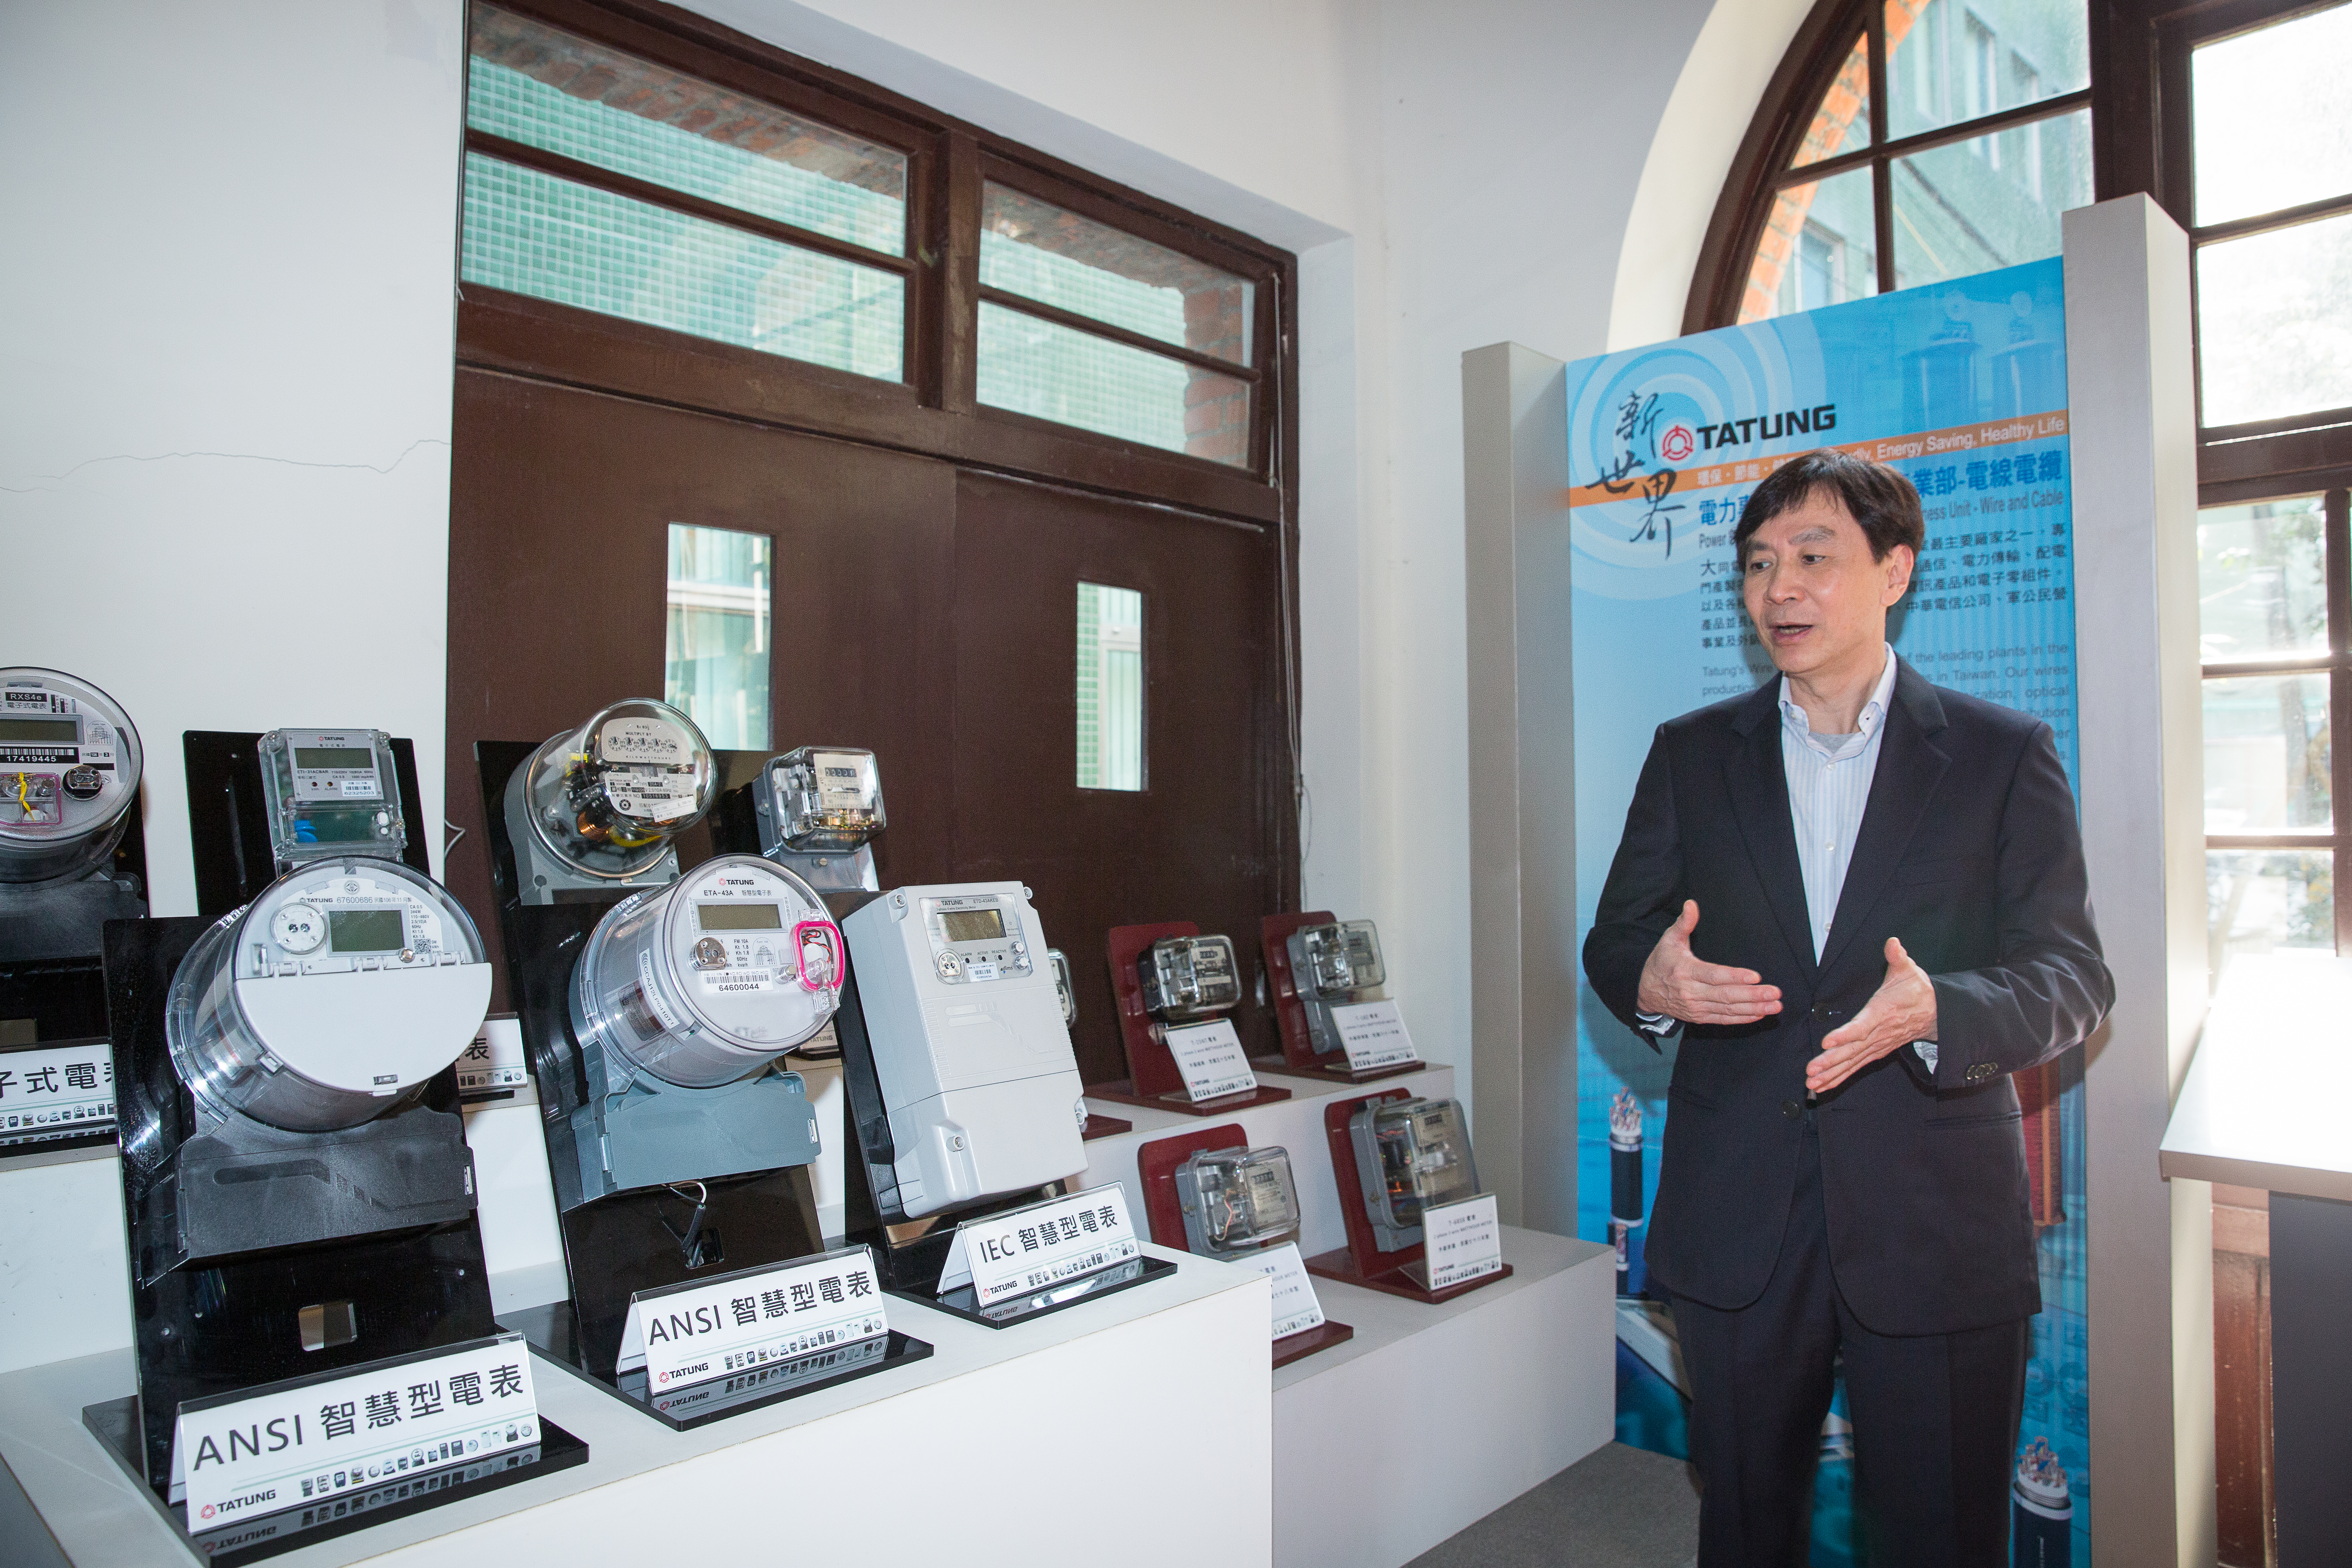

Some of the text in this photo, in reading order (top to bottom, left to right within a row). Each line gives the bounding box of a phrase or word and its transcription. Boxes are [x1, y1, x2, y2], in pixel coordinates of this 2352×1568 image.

[1696, 403, 1836, 450] TATUNG
[1877, 442, 1924, 461] Energy
[1981, 423, 2035, 443] Healthy
[2038, 416, 2065, 434] Life
[1980, 497, 2005, 514] Wire
[2008, 493, 2028, 510] and
[2031, 489, 2063, 508] Cable
[719, 983, 760, 991] 64600044
[980, 1205, 1118, 1263] IEC 智慧型電表
[989, 1280, 1018, 1294] TATUNG
[649, 1270, 872, 1345] ANSI 智慧型電表
[669, 1363, 708, 1379] TATUNG
[194, 1364, 523, 1470] ANSI 智慧型電表
[217, 1489, 276, 1513] TATUNG
